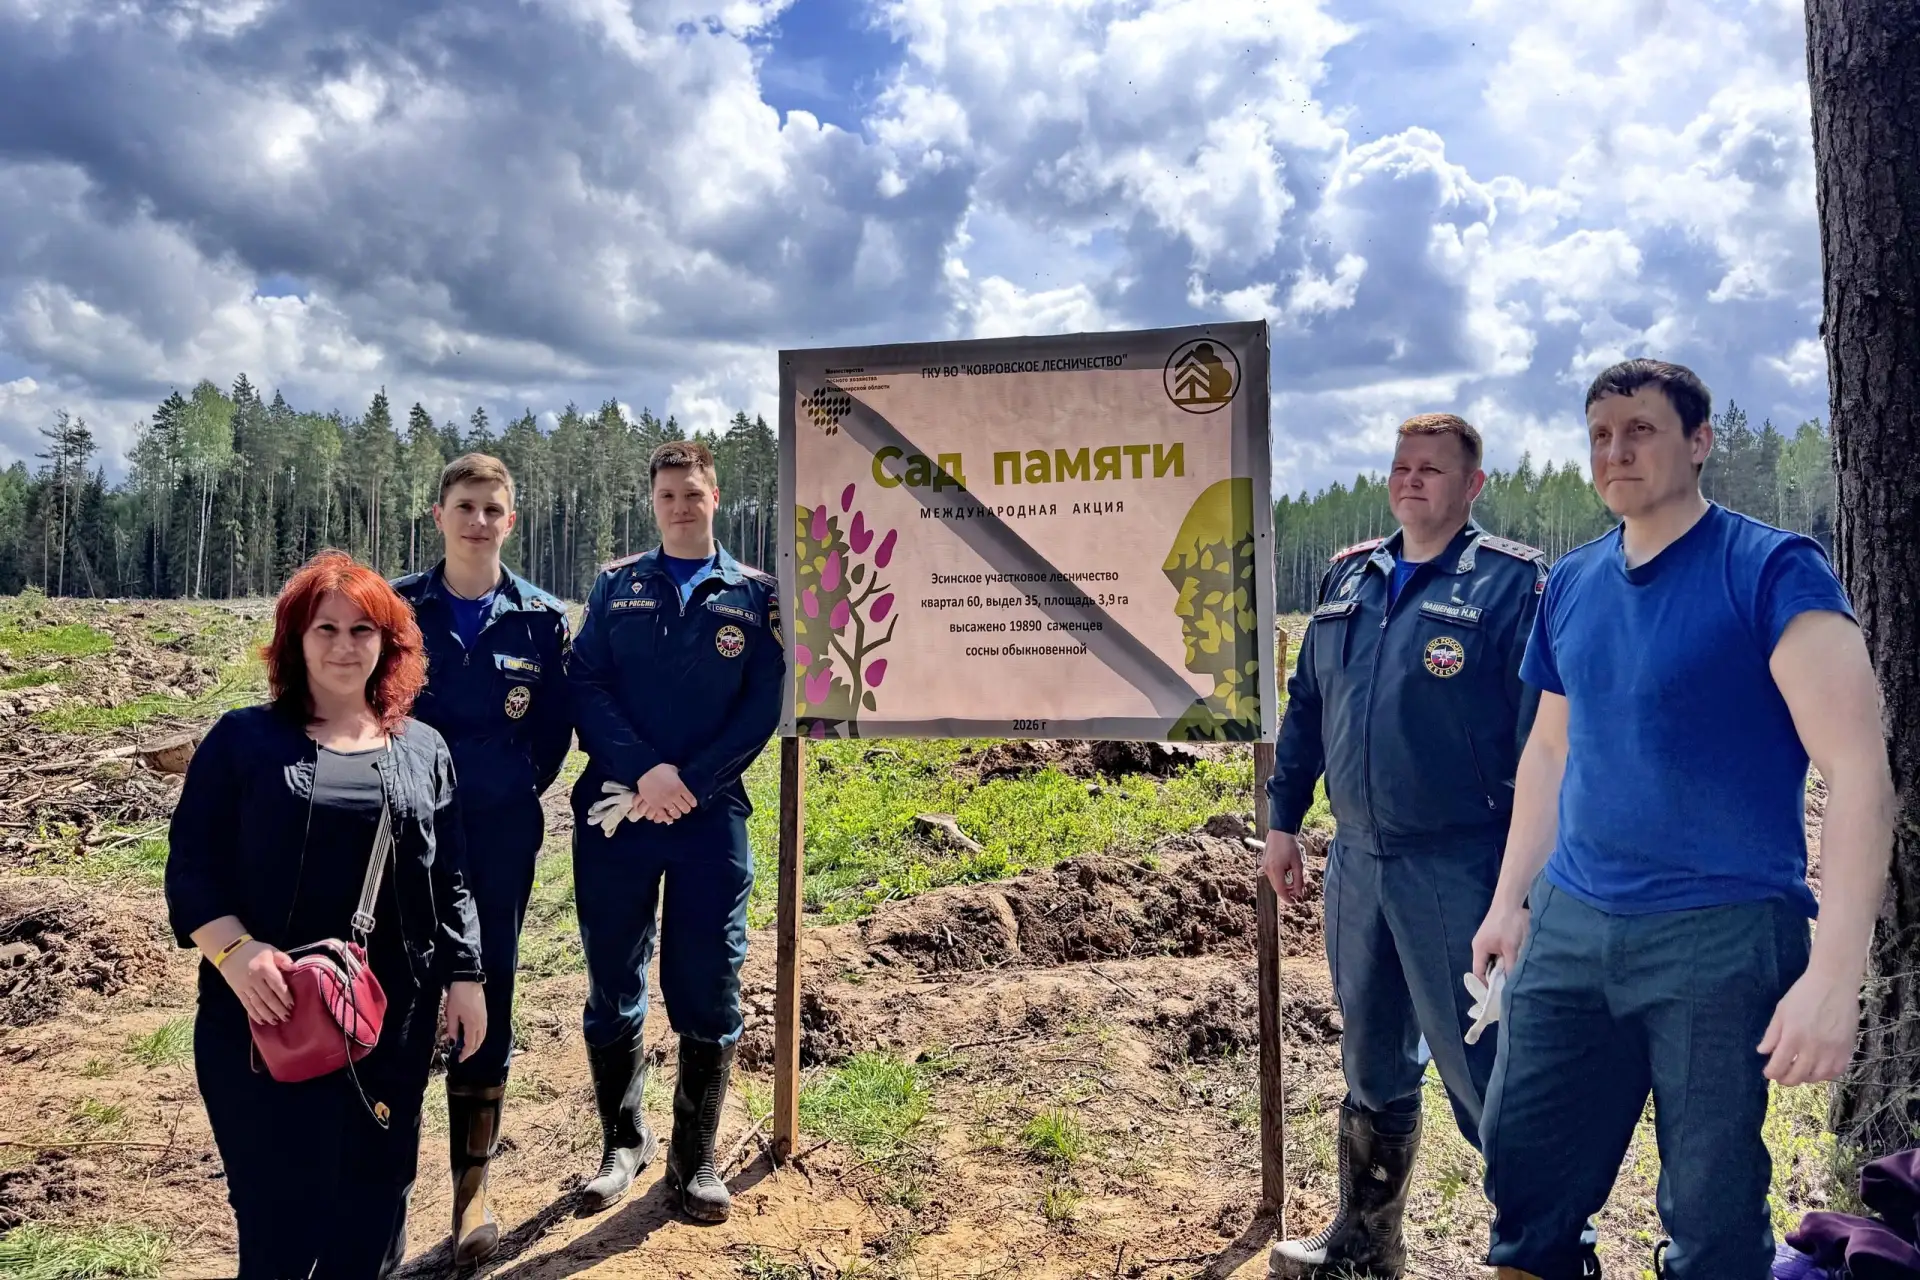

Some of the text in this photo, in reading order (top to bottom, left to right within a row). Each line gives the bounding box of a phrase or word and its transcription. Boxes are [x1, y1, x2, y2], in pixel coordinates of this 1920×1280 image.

[922, 353, 1128, 379] ГКУ ВО "КОВРОВСКОЕ ЛЕСНИЧЕСТВО"
[871, 442, 1185, 492] Сад памяти
[920, 501, 1124, 520] МЕЖДУНАРОДНАЯ АКЦИЯ
[931, 571, 1119, 586] Эсинское участковое лесничество
[612, 599, 655, 609] МЧС РОССИИ
[921, 593, 1129, 609] квартал 60, выдел 35, площадь 3,9 га
[949, 620, 1103, 633] высажено 19890 саженцев
[965, 642, 1087, 656] сосны обыкновенной
[1012, 719, 1047, 730] 2026 г
